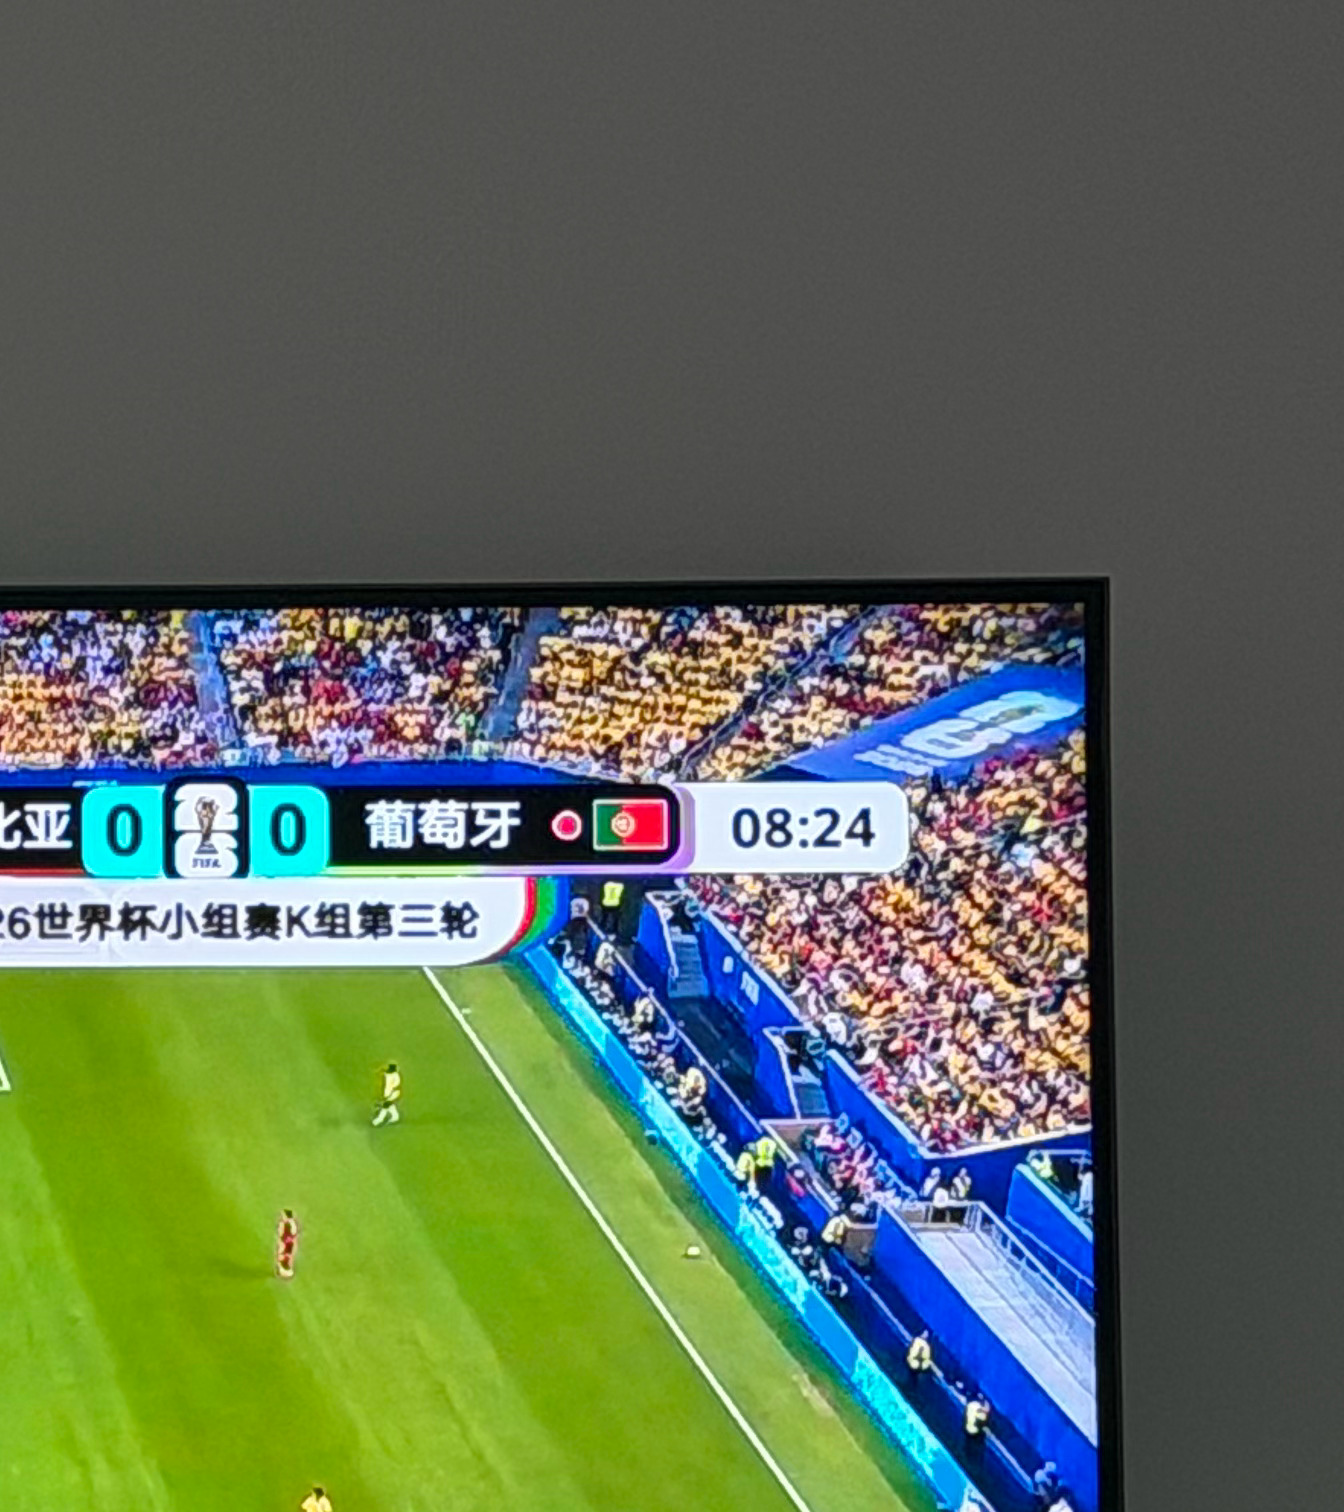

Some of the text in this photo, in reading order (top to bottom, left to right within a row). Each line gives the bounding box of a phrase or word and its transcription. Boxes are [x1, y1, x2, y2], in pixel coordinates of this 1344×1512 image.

[106, 804, 143, 857] 0
[269, 803, 307, 857] 0
[364, 800, 522, 850] 葡萄牙
[731, 807, 876, 849] 08:24
